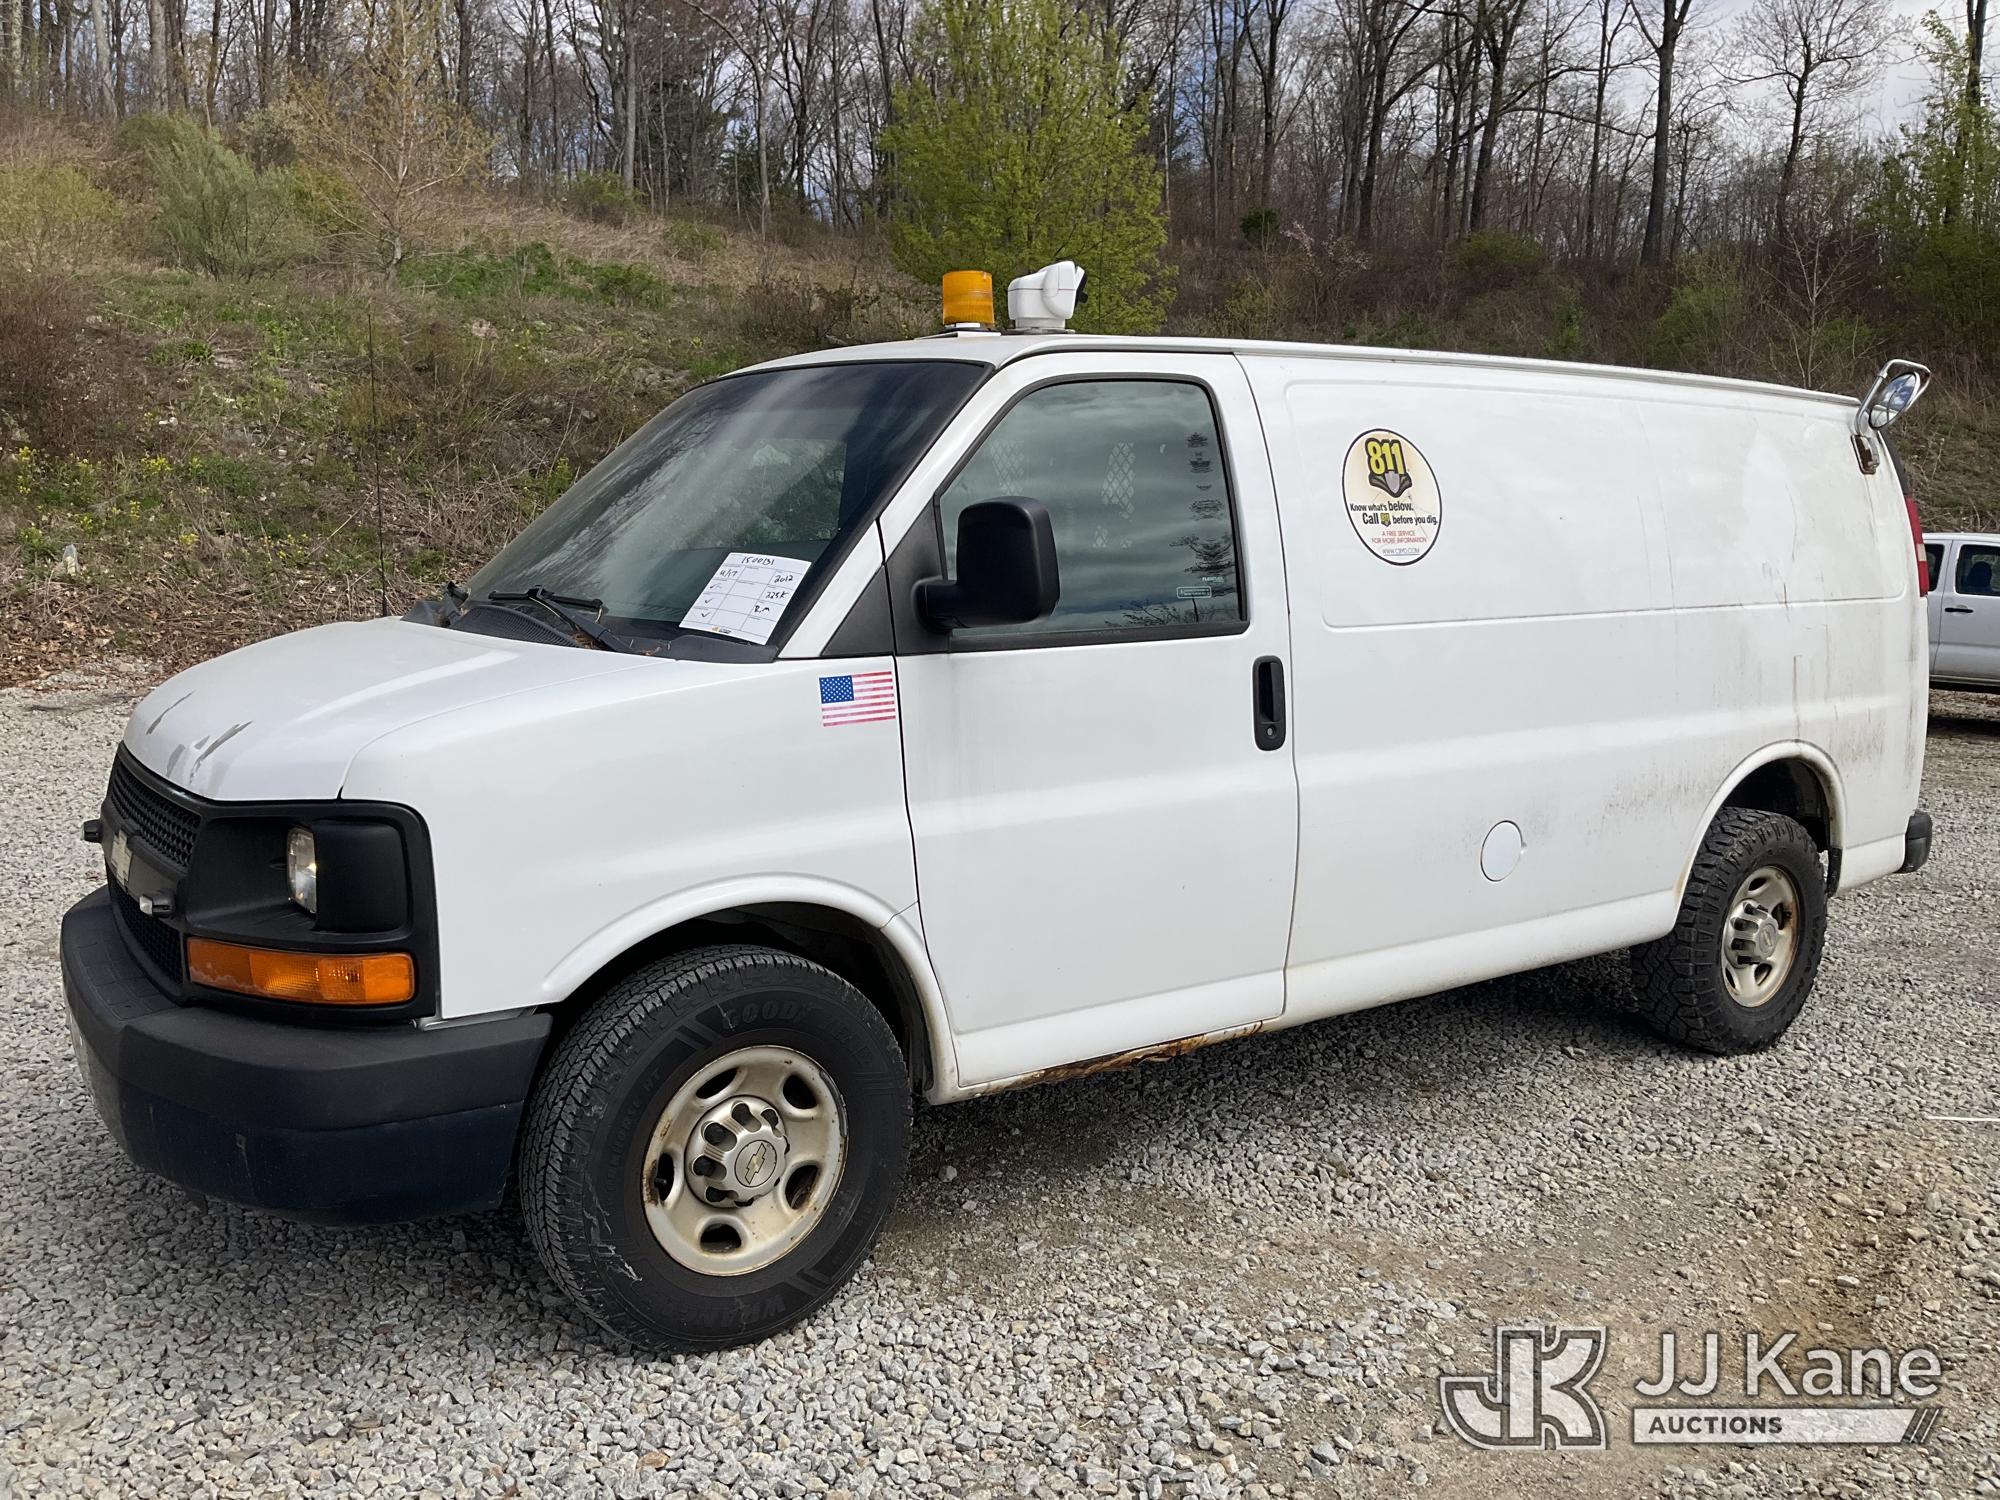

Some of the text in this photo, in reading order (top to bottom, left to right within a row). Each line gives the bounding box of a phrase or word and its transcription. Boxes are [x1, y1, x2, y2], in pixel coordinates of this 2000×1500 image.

[1366, 440, 1406, 475] 811
[1350, 501, 1414, 511] Know what's below.
[1363, 513, 1379, 524] Call
[1392, 515, 1413, 524] before
[1414, 516, 1425, 525] you
[1427, 515, 1438, 525] dig.
[774, 575, 793, 583] 2012
